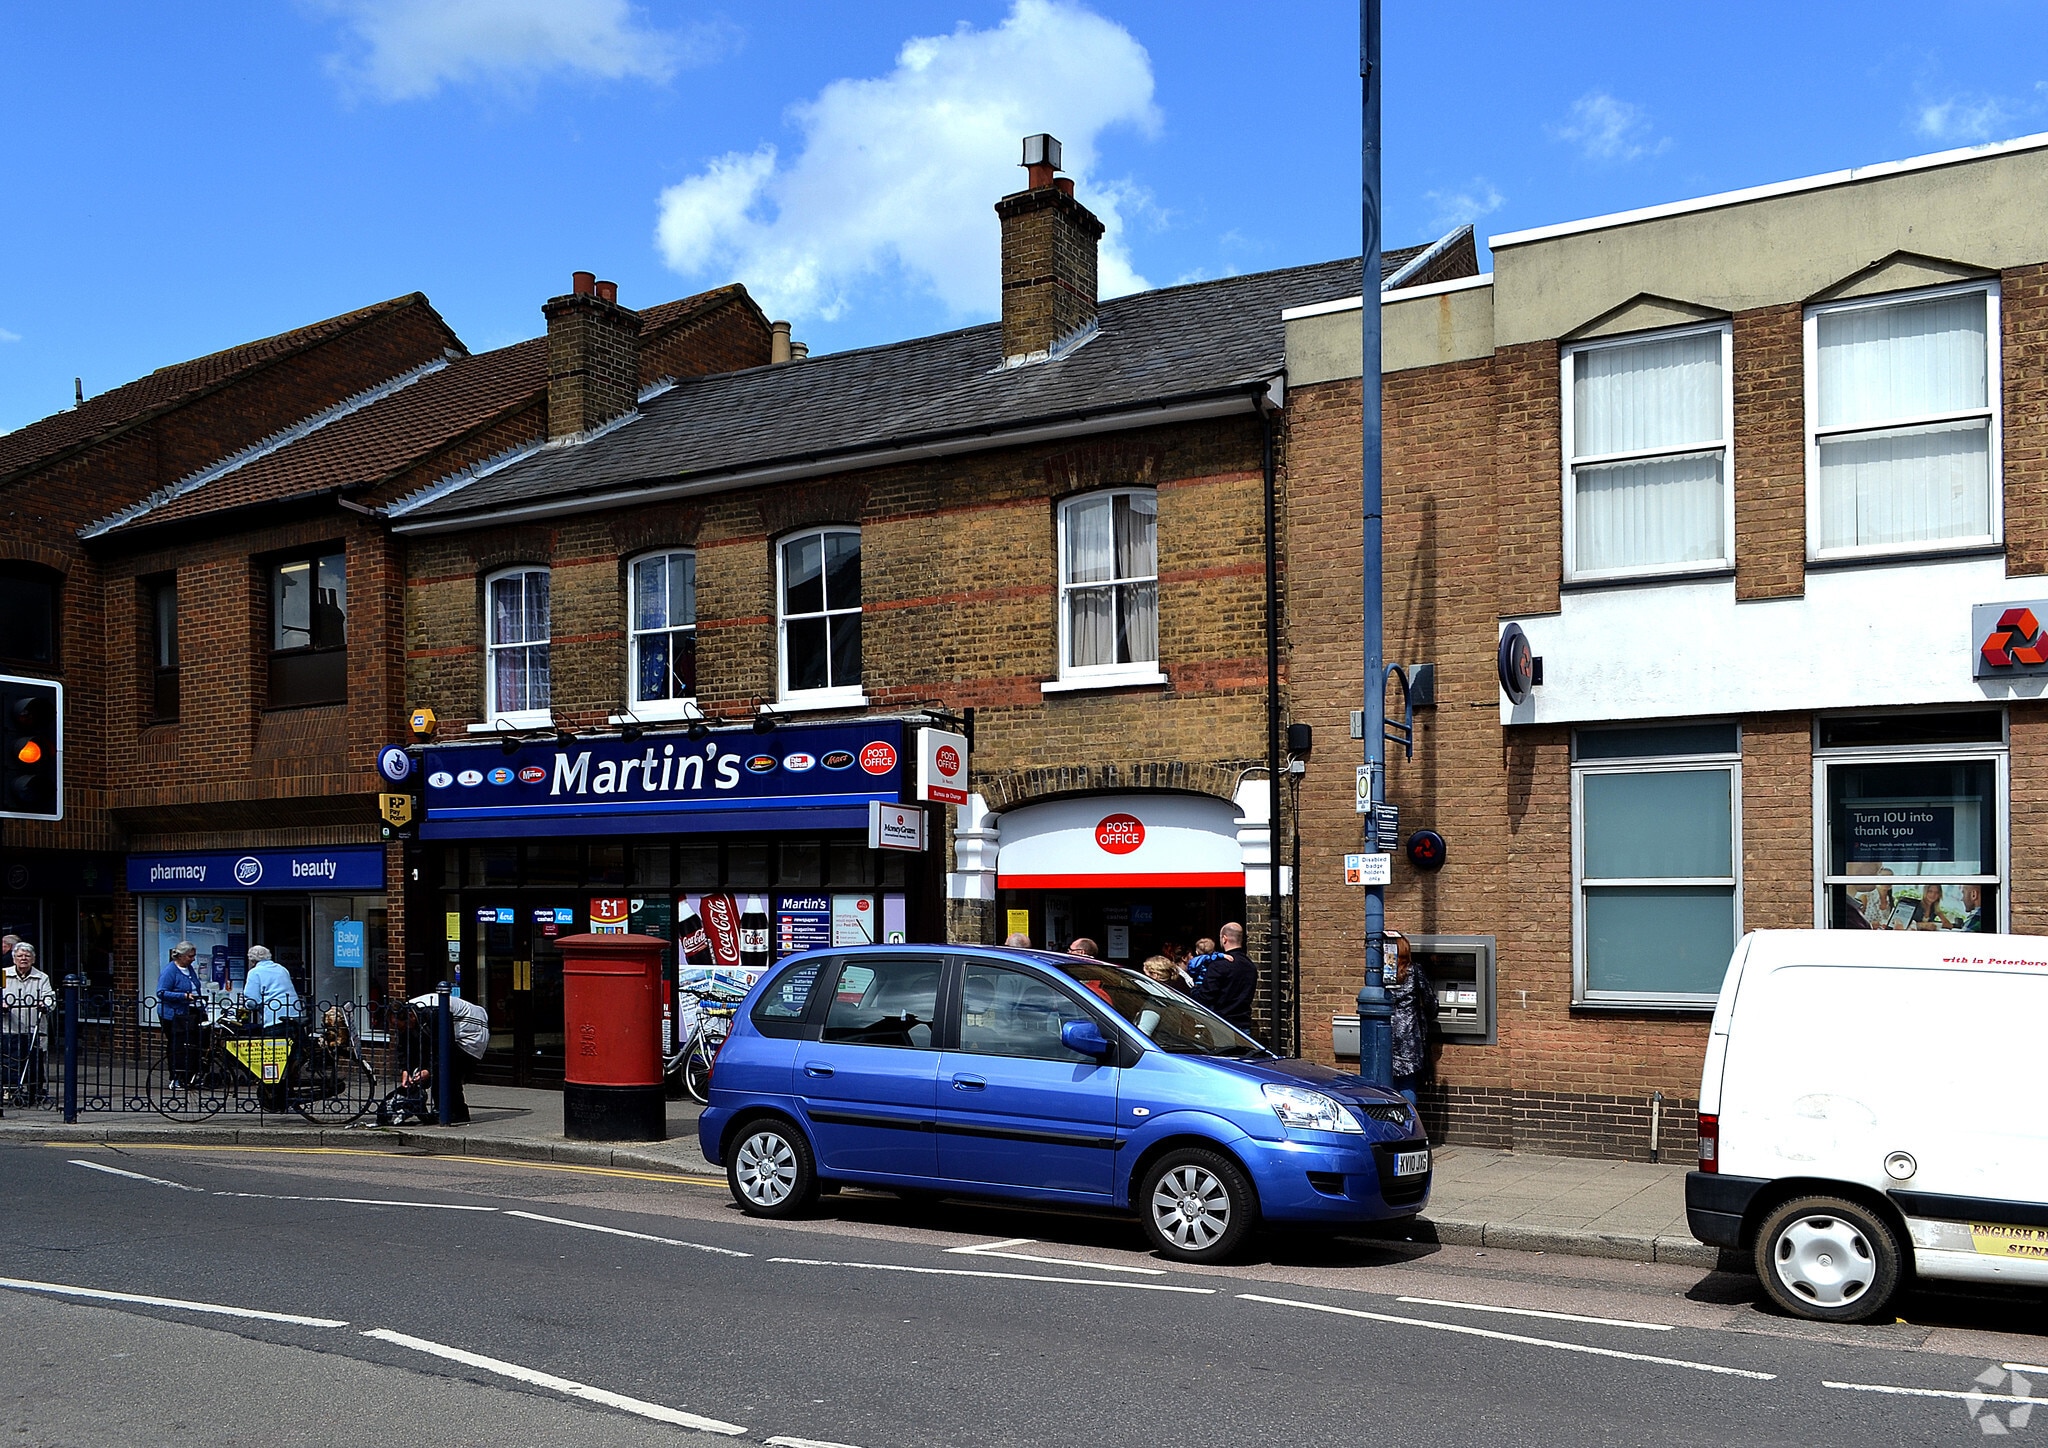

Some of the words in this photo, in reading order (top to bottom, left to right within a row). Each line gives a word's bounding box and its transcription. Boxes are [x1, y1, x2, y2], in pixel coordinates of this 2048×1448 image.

[867, 748, 889, 758] POST
[941, 751, 956, 761] POST
[827, 755, 848, 765] Mars
[864, 757, 893, 767] OFFICE
[937, 759, 957, 770] OFFICE
[550, 742, 742, 796] Martin's
[1853, 812, 1880, 823] Turn
[1883, 812, 1906, 823] IOU
[1909, 812, 1934, 822] into
[1106, 821, 1135, 833] POST
[1853, 825, 1889, 836] thank
[1892, 828, 1914, 838] you
[1100, 833, 1139, 845] OFFICE
[150, 863, 206, 882] pharmacy
[292, 859, 337, 879] beauty
[600, 899, 618, 917] £1
[782, 898, 827, 909] Martin's
[164, 905, 177, 923] 3
[212, 905, 224, 923] 2
[499, 911, 514, 922] here
[557, 911, 573, 922] here
[1135, 908, 1153, 919] here
[337, 931, 359, 945] Baby
[744, 934, 764, 945] Coke
[336, 945, 360, 957] Event
[1973, 1225, 2034, 1241] ENGLISH
